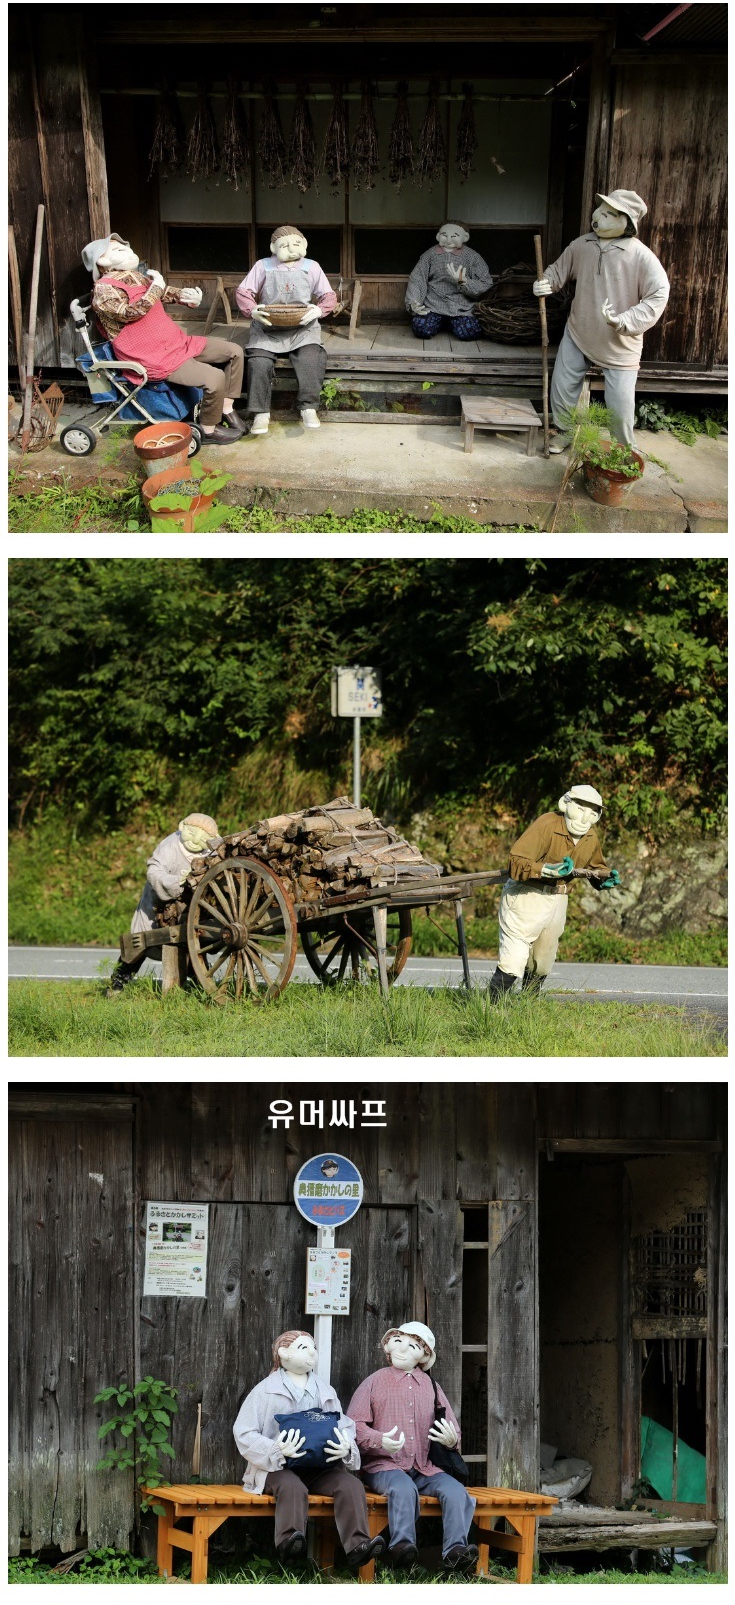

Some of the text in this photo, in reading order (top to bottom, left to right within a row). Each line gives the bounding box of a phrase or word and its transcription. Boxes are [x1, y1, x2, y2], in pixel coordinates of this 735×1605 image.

[348, 692, 368, 702] SEKI
[298, 1182, 360, 1198] 奥播磨かかしの里
